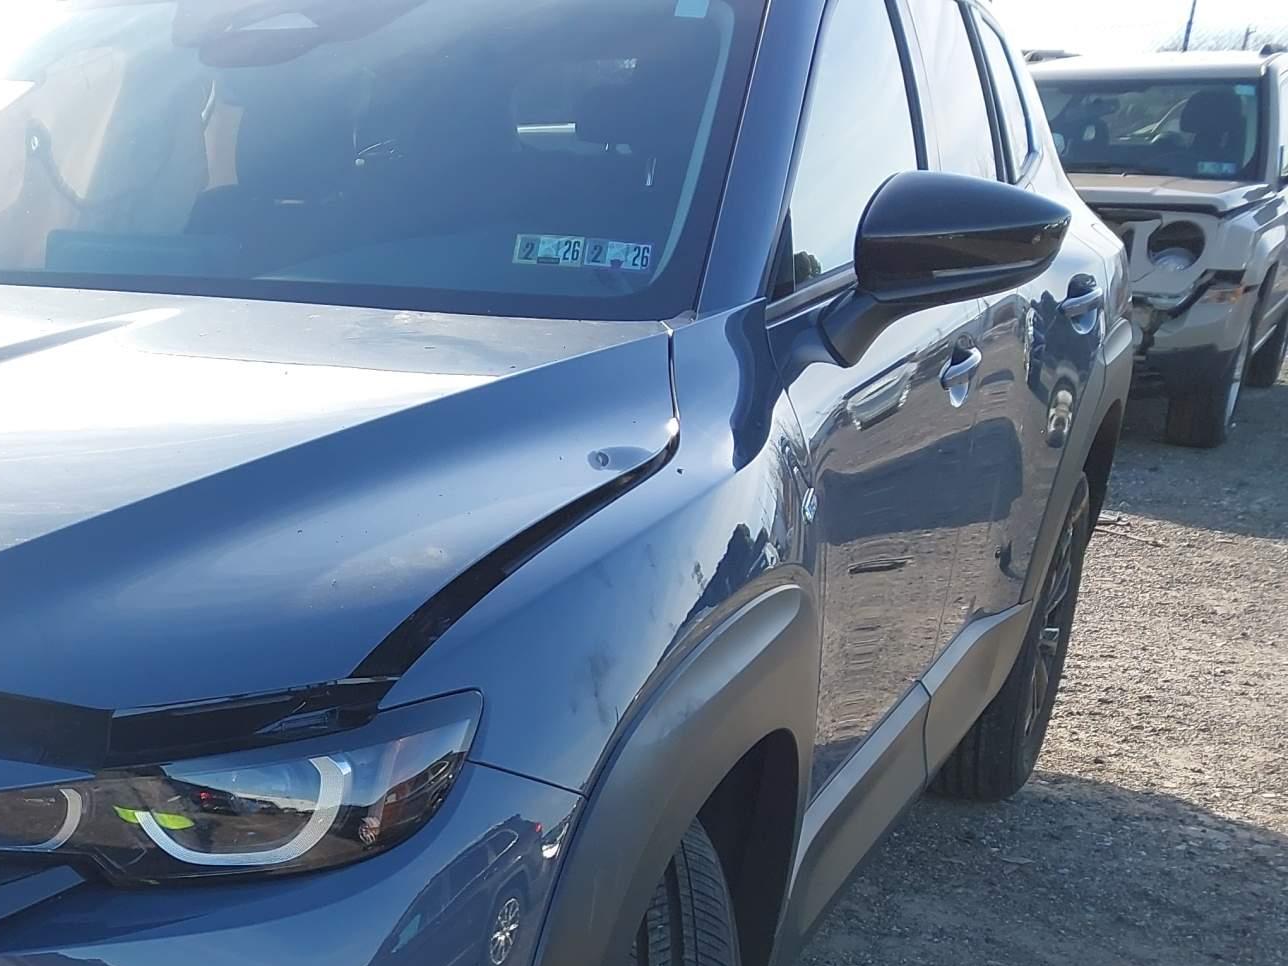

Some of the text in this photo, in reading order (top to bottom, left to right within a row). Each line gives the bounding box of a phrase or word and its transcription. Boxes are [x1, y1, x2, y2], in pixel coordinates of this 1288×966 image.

[522, 240, 581, 261] 2 26
[591, 244, 650, 267] 2 26
